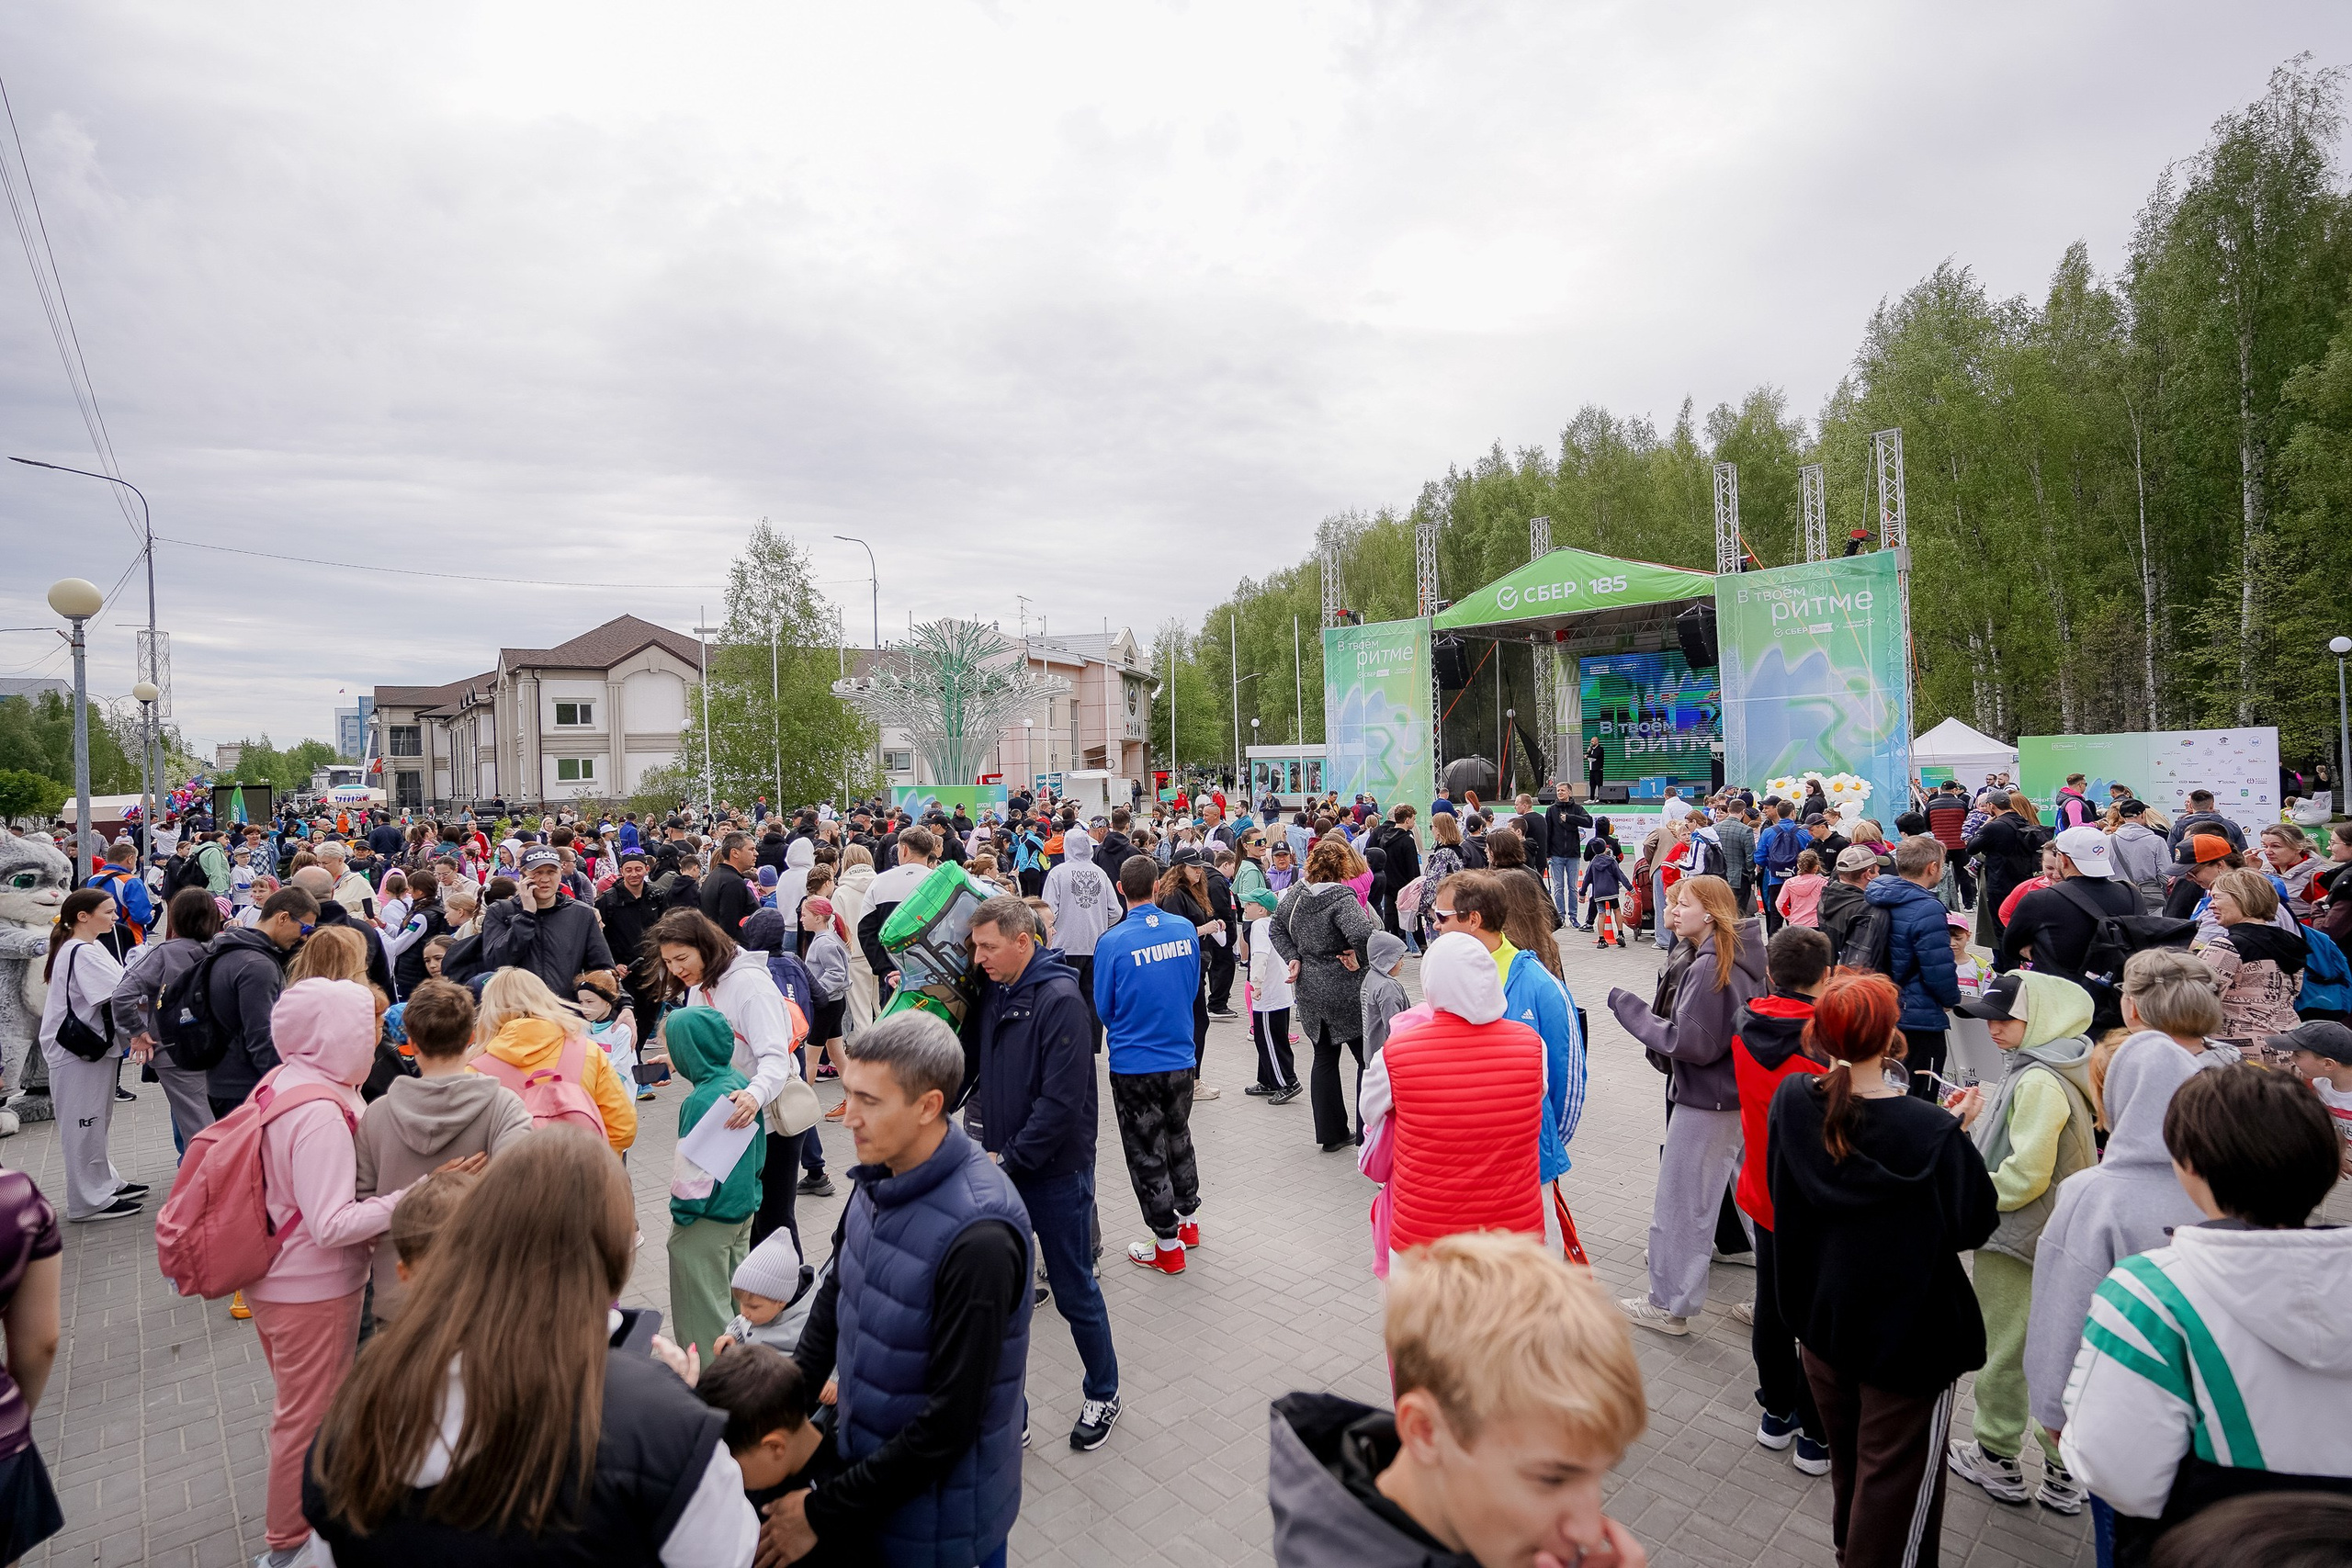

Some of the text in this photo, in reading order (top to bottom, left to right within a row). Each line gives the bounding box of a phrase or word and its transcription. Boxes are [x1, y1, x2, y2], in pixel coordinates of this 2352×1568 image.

[1523, 574, 1628, 604] СБЕР 185
[1737, 585, 1806, 604] В твоём
[1770, 590, 1874, 626] ритме
[1785, 627, 1808, 636] СБЕР
[1338, 637, 1379, 651] В твоём
[1357, 646, 1414, 670] ритме
[1600, 717, 1677, 734] В твоём
[1624, 735, 1715, 760] ритм
[1650, 782, 1657, 794] 1
[526, 851, 560, 862] adidas
[1071, 870, 1100, 879] РОССИЯ
[1130, 939, 1193, 966] TYUMEN
